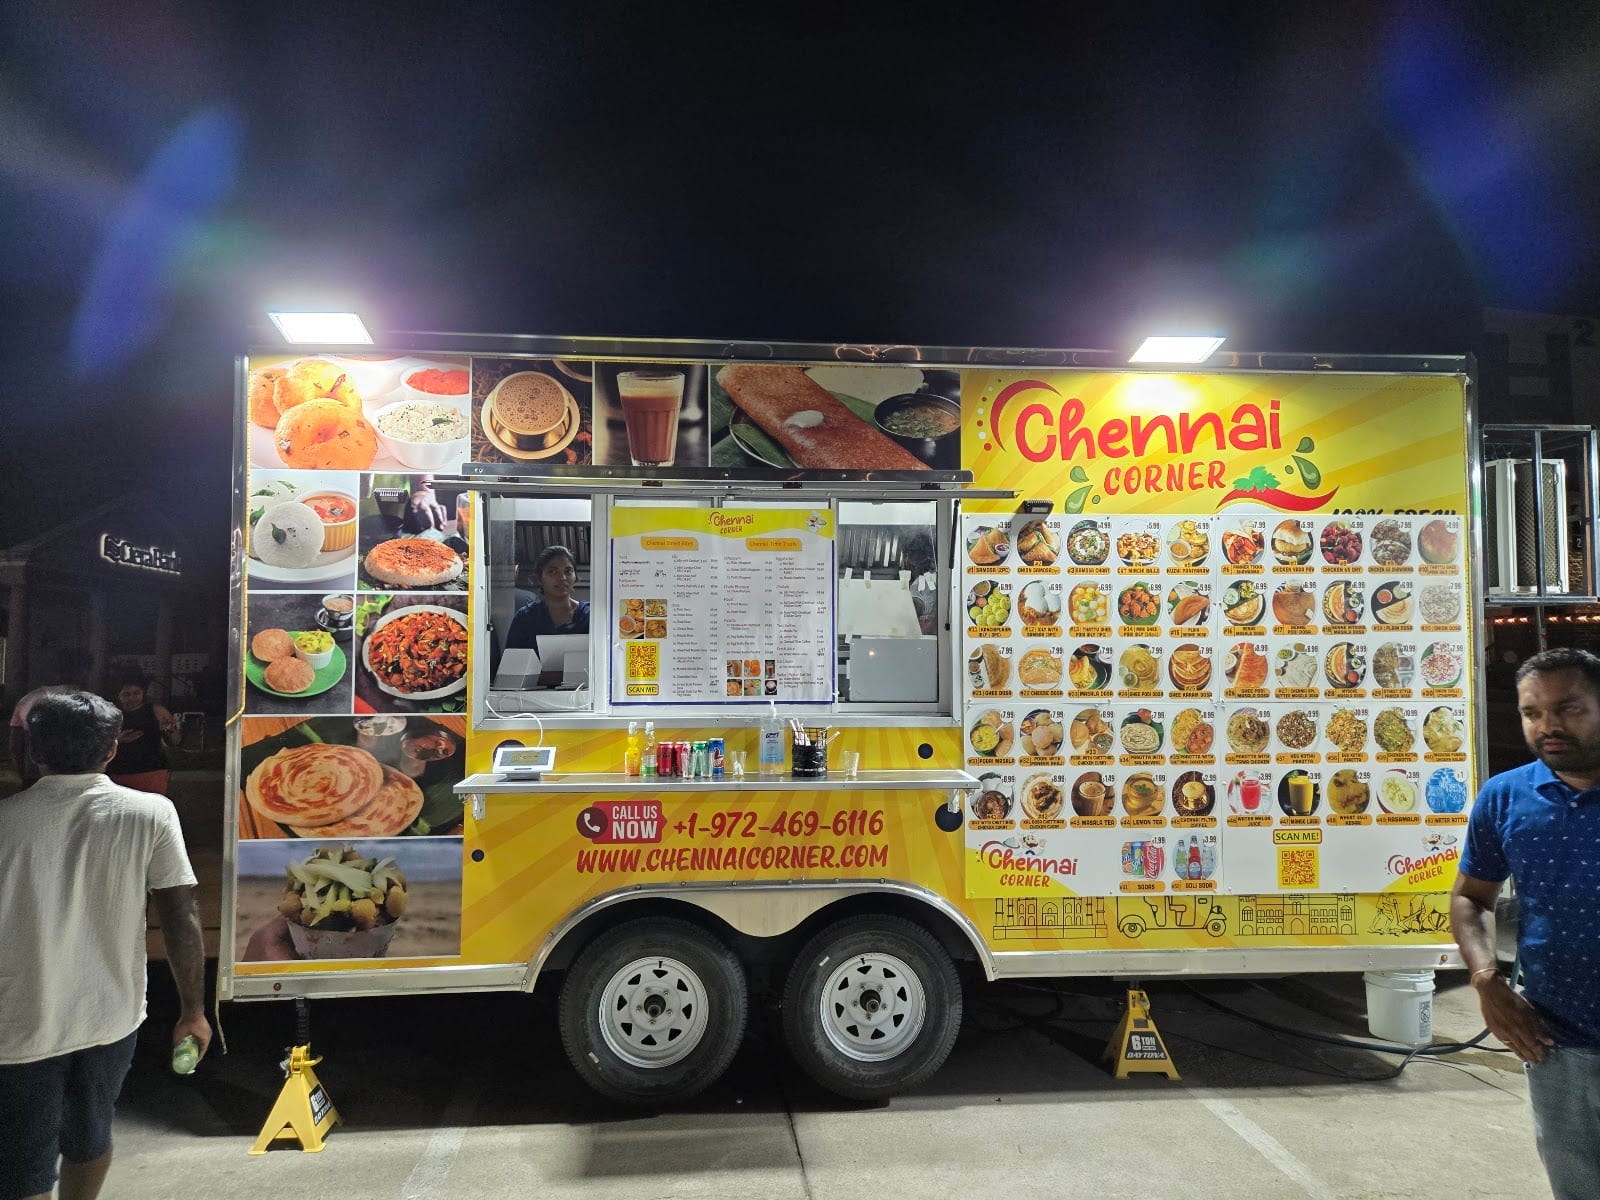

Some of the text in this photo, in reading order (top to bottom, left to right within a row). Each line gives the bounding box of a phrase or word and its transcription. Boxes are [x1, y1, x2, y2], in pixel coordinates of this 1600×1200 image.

[1015, 398, 1281, 463] Chennai
[1104, 460, 1226, 495] CORNER
[714, 514, 754, 526] Chennai
[720, 526, 743, 535] CORNER
[612, 806, 658, 819] CALL US
[612, 821, 658, 839] NOW
[674, 809, 884, 838] +1-972-469-6116
[1275, 832, 1319, 840] SCAN ME!
[577, 844, 889, 873] WWW.CHENNAICORNER.COM
[989, 848, 1078, 875] Chennai
[1394, 846, 1459, 875] Chennai
[1000, 874, 1050, 887] CORNER
[1408, 865, 1443, 885] CORNER
[1131, 1035, 1142, 1050] 6
